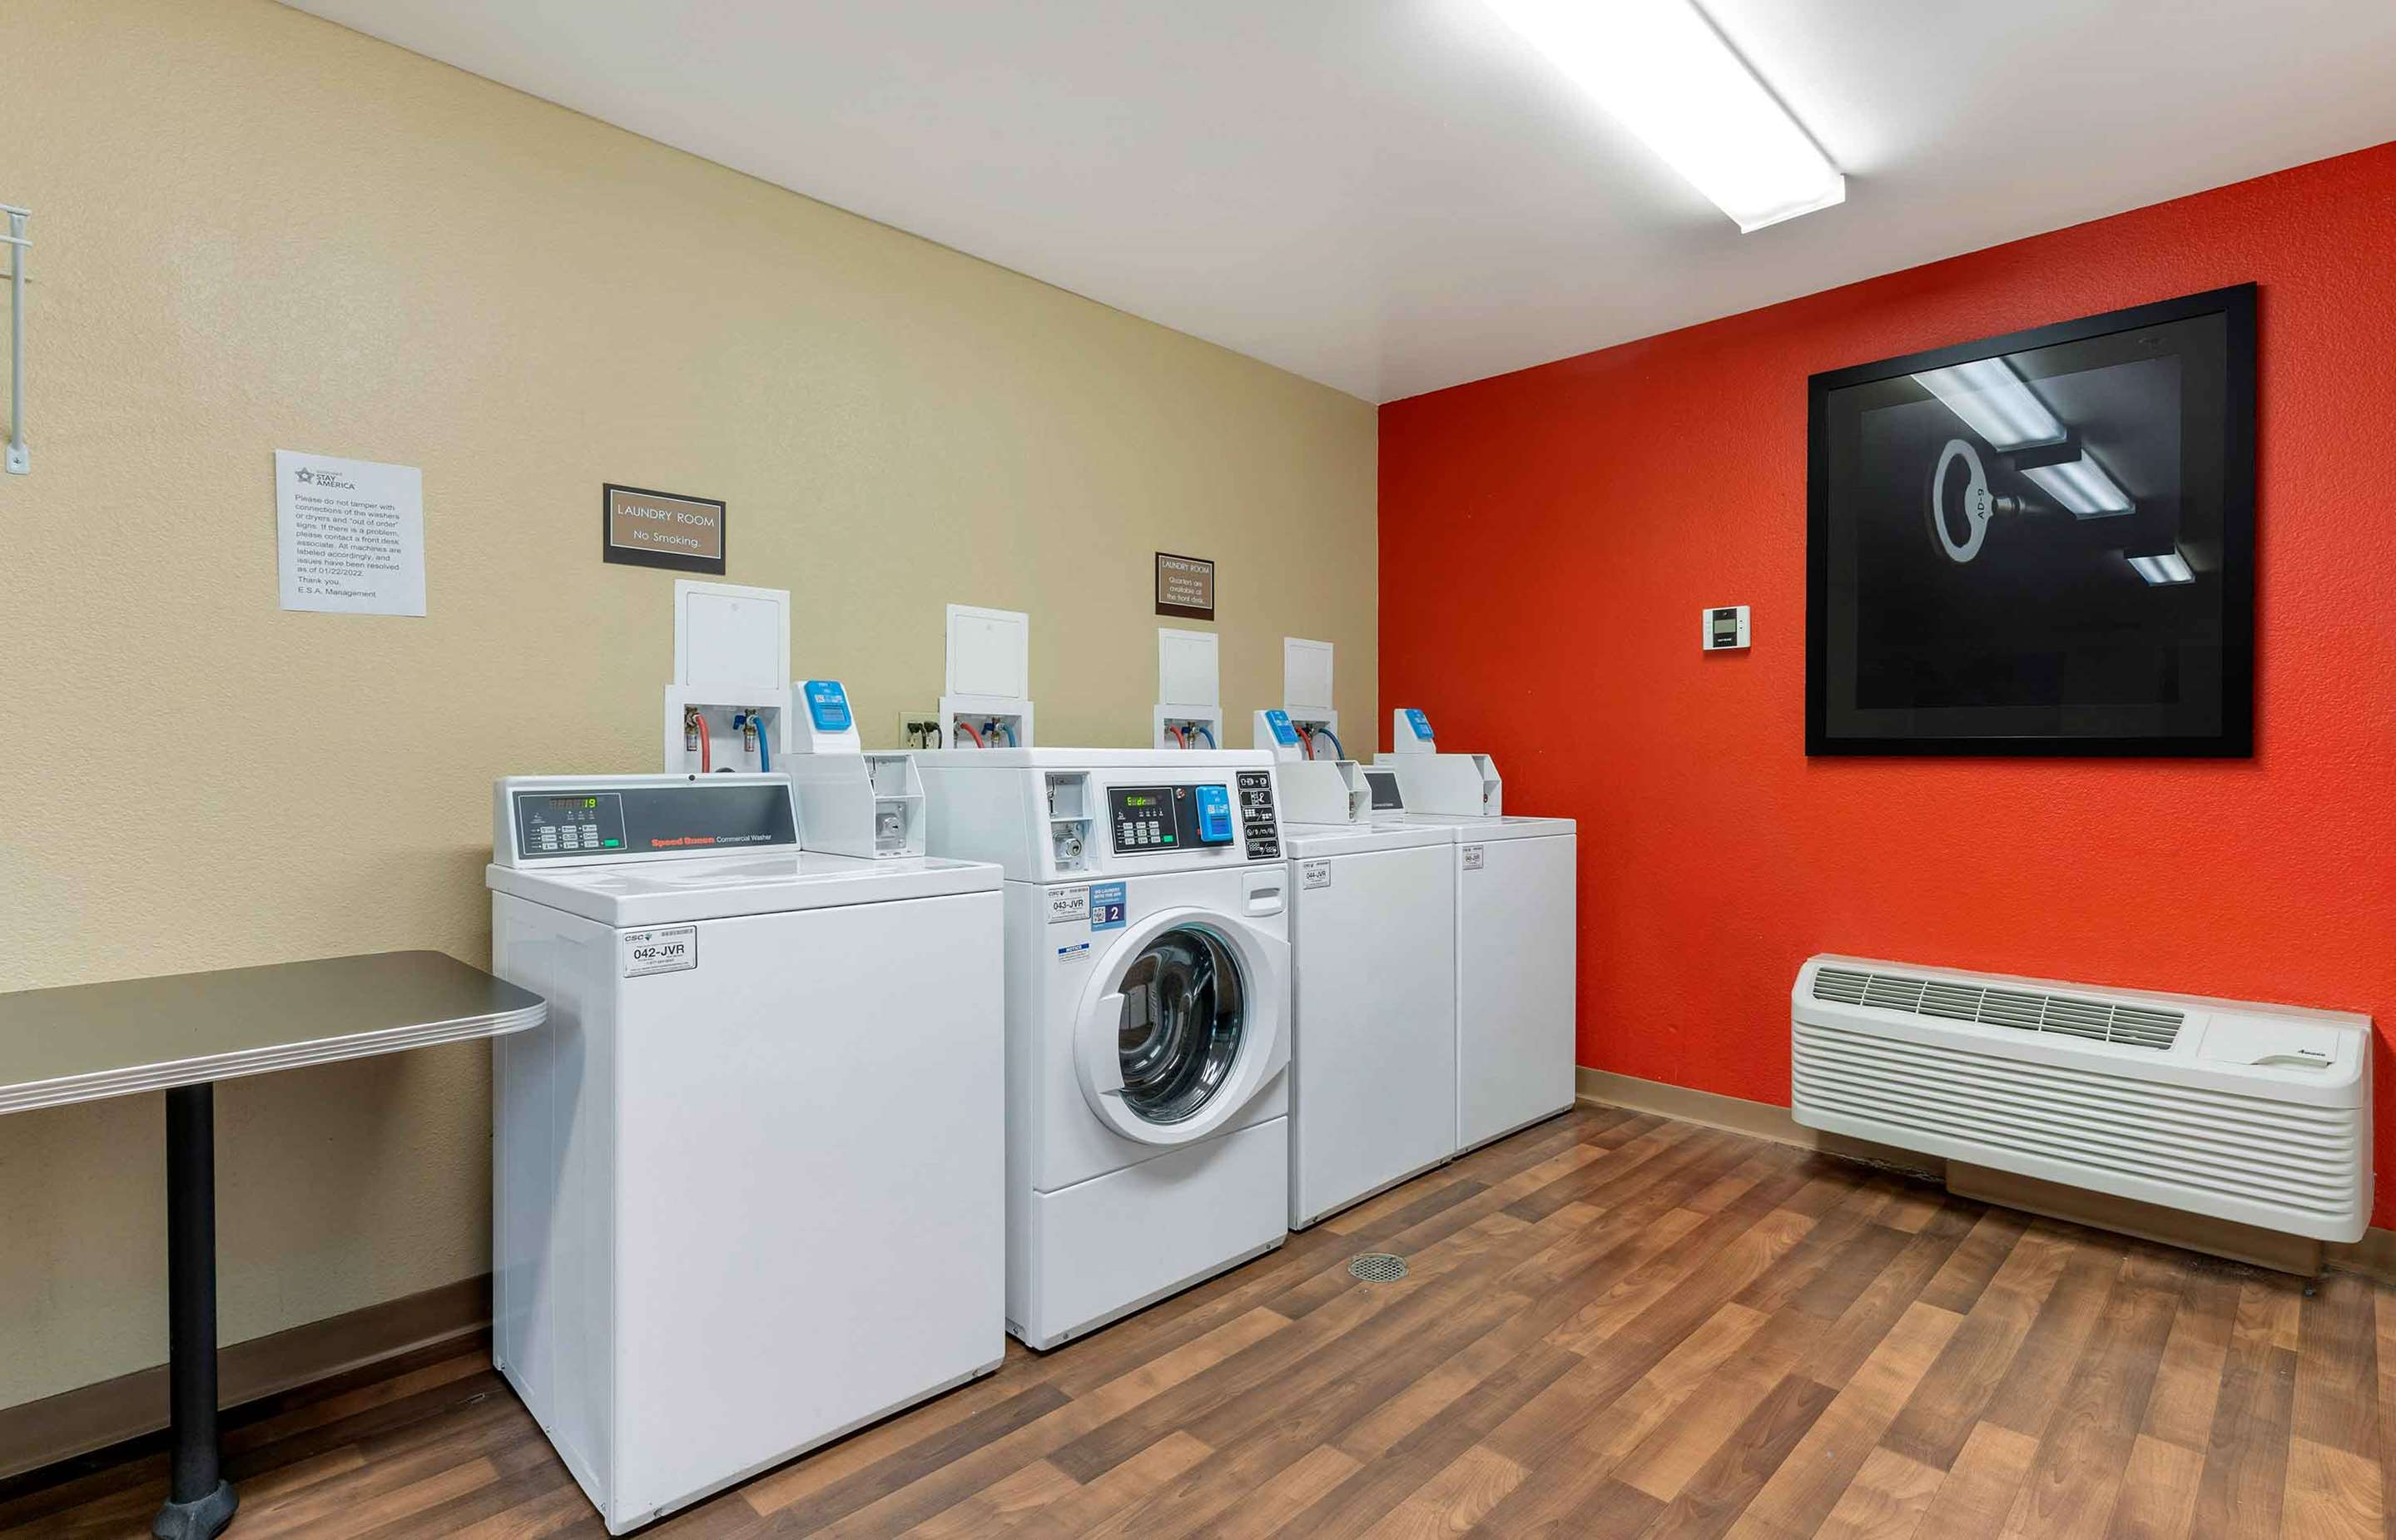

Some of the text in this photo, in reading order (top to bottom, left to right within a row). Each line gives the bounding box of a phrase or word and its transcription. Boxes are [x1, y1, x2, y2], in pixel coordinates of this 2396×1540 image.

[317, 480, 355, 489] AMERICA
[295, 494, 322, 503] Please
[350, 501, 378, 510] tamper
[295, 504, 342, 514] connections
[305, 513, 330, 522] dryers
[618, 504, 715, 527] LAUNDRY ROOM
[329, 525, 348, 533] there
[296, 531, 322, 540] please
[361, 536, 379, 544] front
[633, 531, 701, 548] No Smoking.
[297, 548, 325, 557] labeled
[350, 544, 386, 552] machines
[1162, 559, 1188, 572] LAUNDRY
[325, 588, 376, 598] Management
[1054, 899, 1084, 910] 043-JVR
[1111, 907, 1119, 919] 2
[634, 944, 684, 959] 042-JVR
